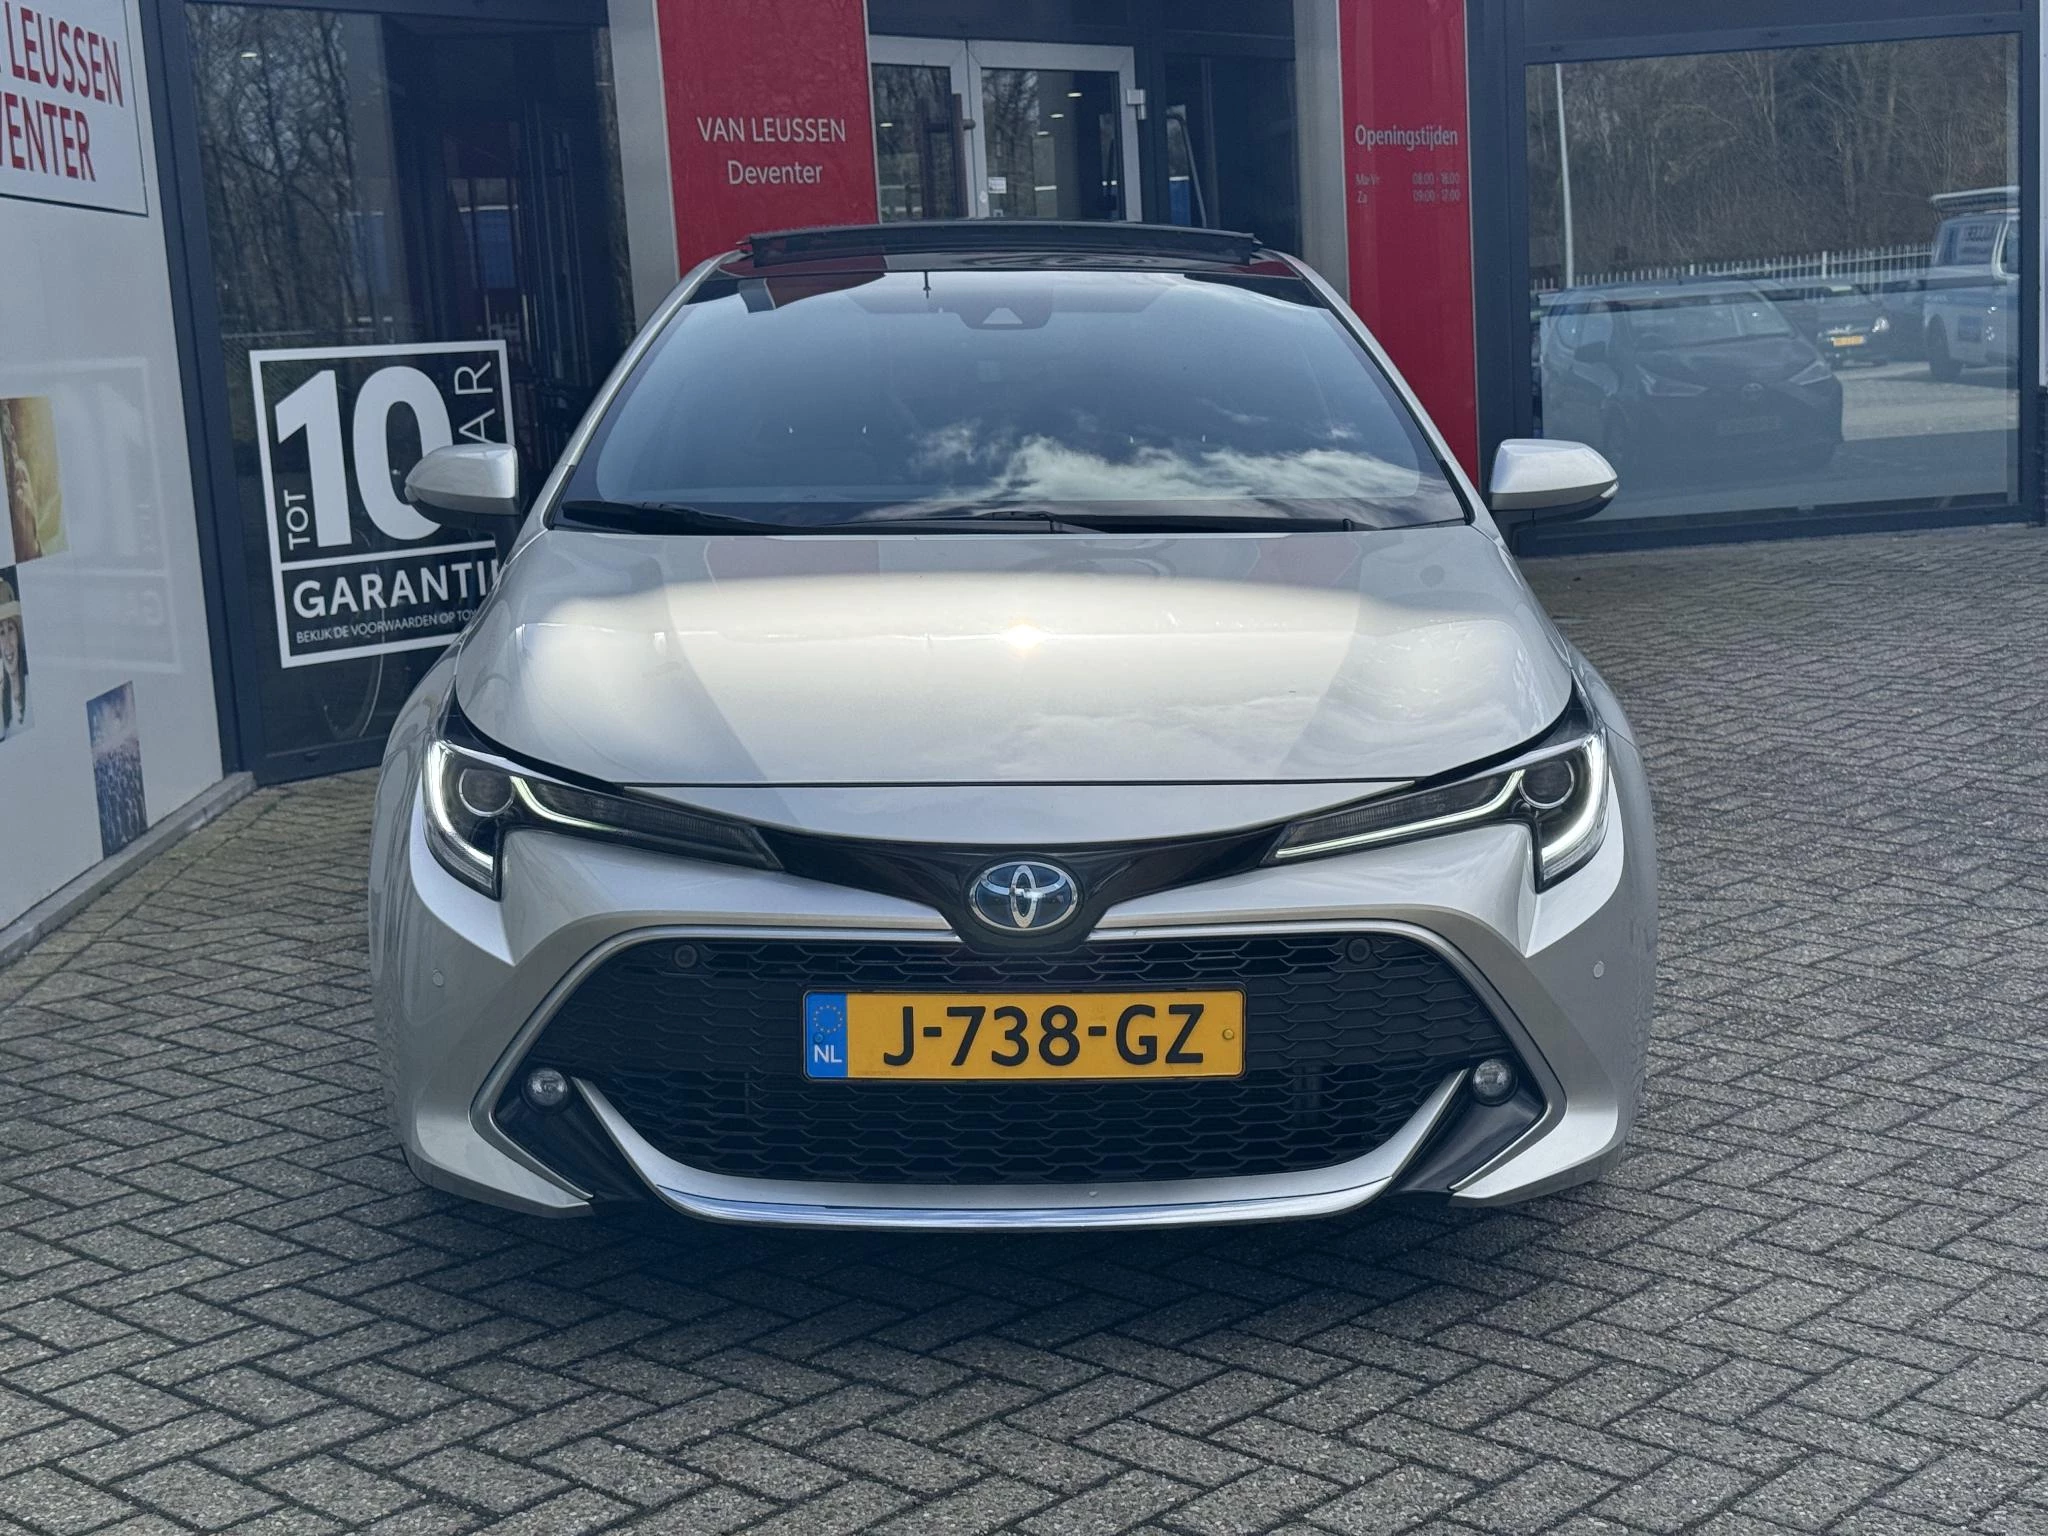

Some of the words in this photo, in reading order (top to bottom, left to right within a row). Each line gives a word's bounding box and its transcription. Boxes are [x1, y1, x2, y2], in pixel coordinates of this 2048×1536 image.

[5, 1, 124, 108] LEUSSEN
[697, 116, 745, 143] VAN
[751, 117, 846, 143] LEUSSEN
[1355, 124, 1459, 151] Openingstijden
[727, 159, 823, 185] Deventer
[275, 365, 453, 548] 10
[283, 490, 310, 551] TOT
[296, 627, 333, 644] BEKIJK
[333, 626, 350, 639] DE
[350, 612, 438, 637] VOORWAARDEN
[439, 610, 456, 624] OP
[883, 1004, 1206, 1067] J-738-GZ
[813, 1044, 843, 1064] NL
